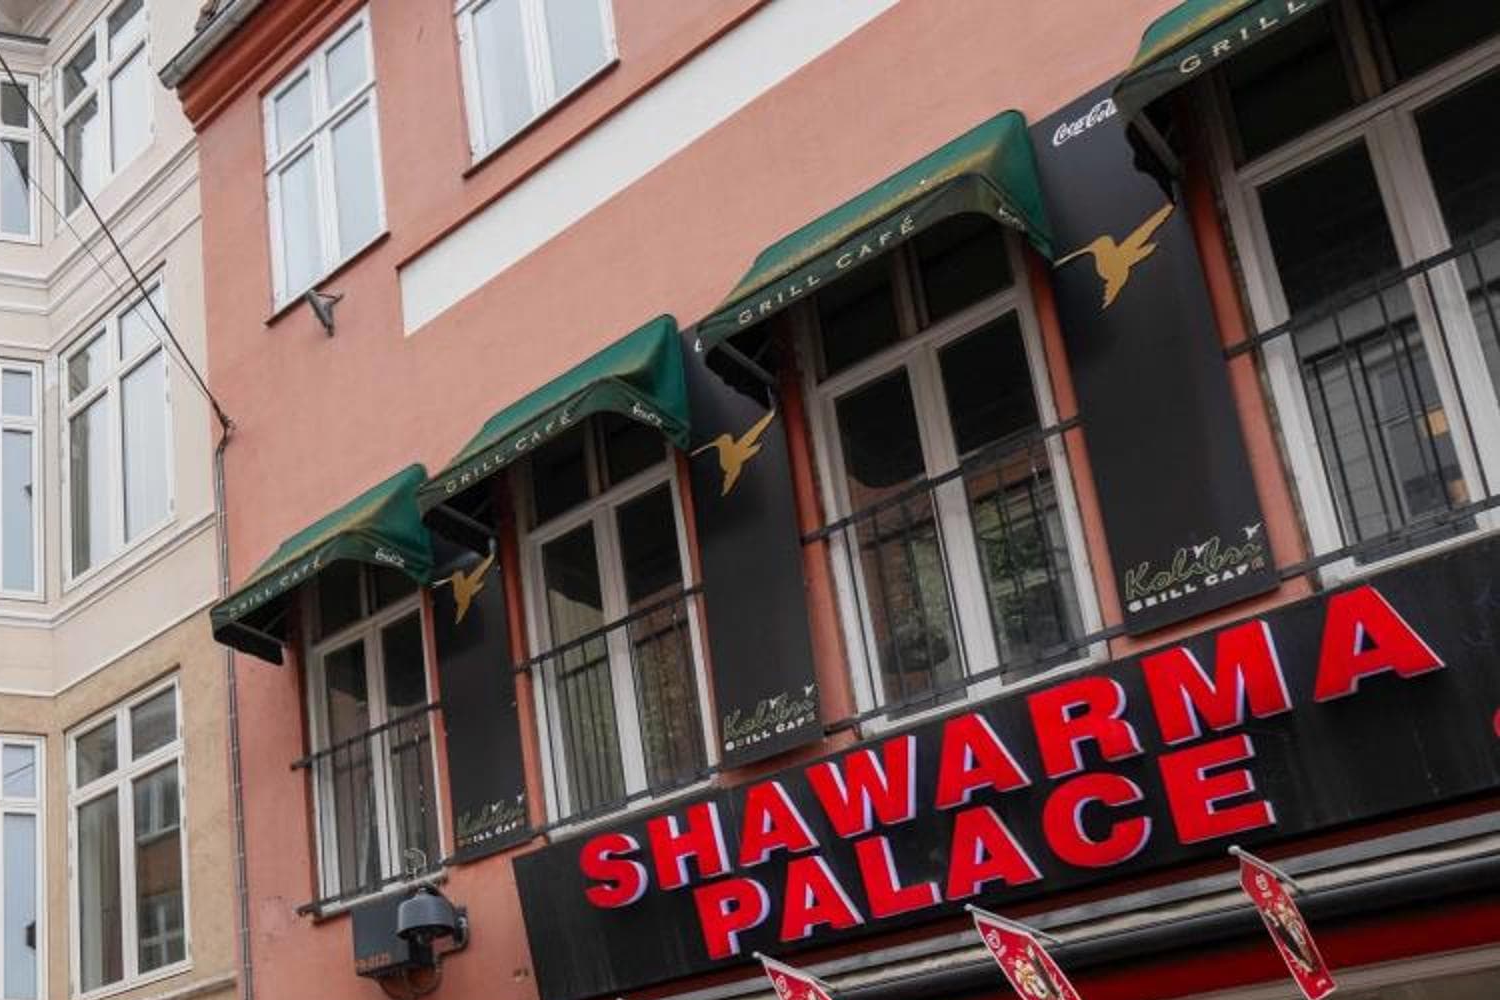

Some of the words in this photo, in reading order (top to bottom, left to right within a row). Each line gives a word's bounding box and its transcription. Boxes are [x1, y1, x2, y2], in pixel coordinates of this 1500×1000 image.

[1180, 2, 1306, 76] GRILL
[738, 273, 821, 326] GRILL
[445, 454, 504, 494] GRILL
[1125, 536, 1262, 601] Kolibri
[1128, 583, 1197, 614] GRILL
[580, 585, 1446, 909] SHAWARMA
[694, 733, 1277, 960] PALACE
